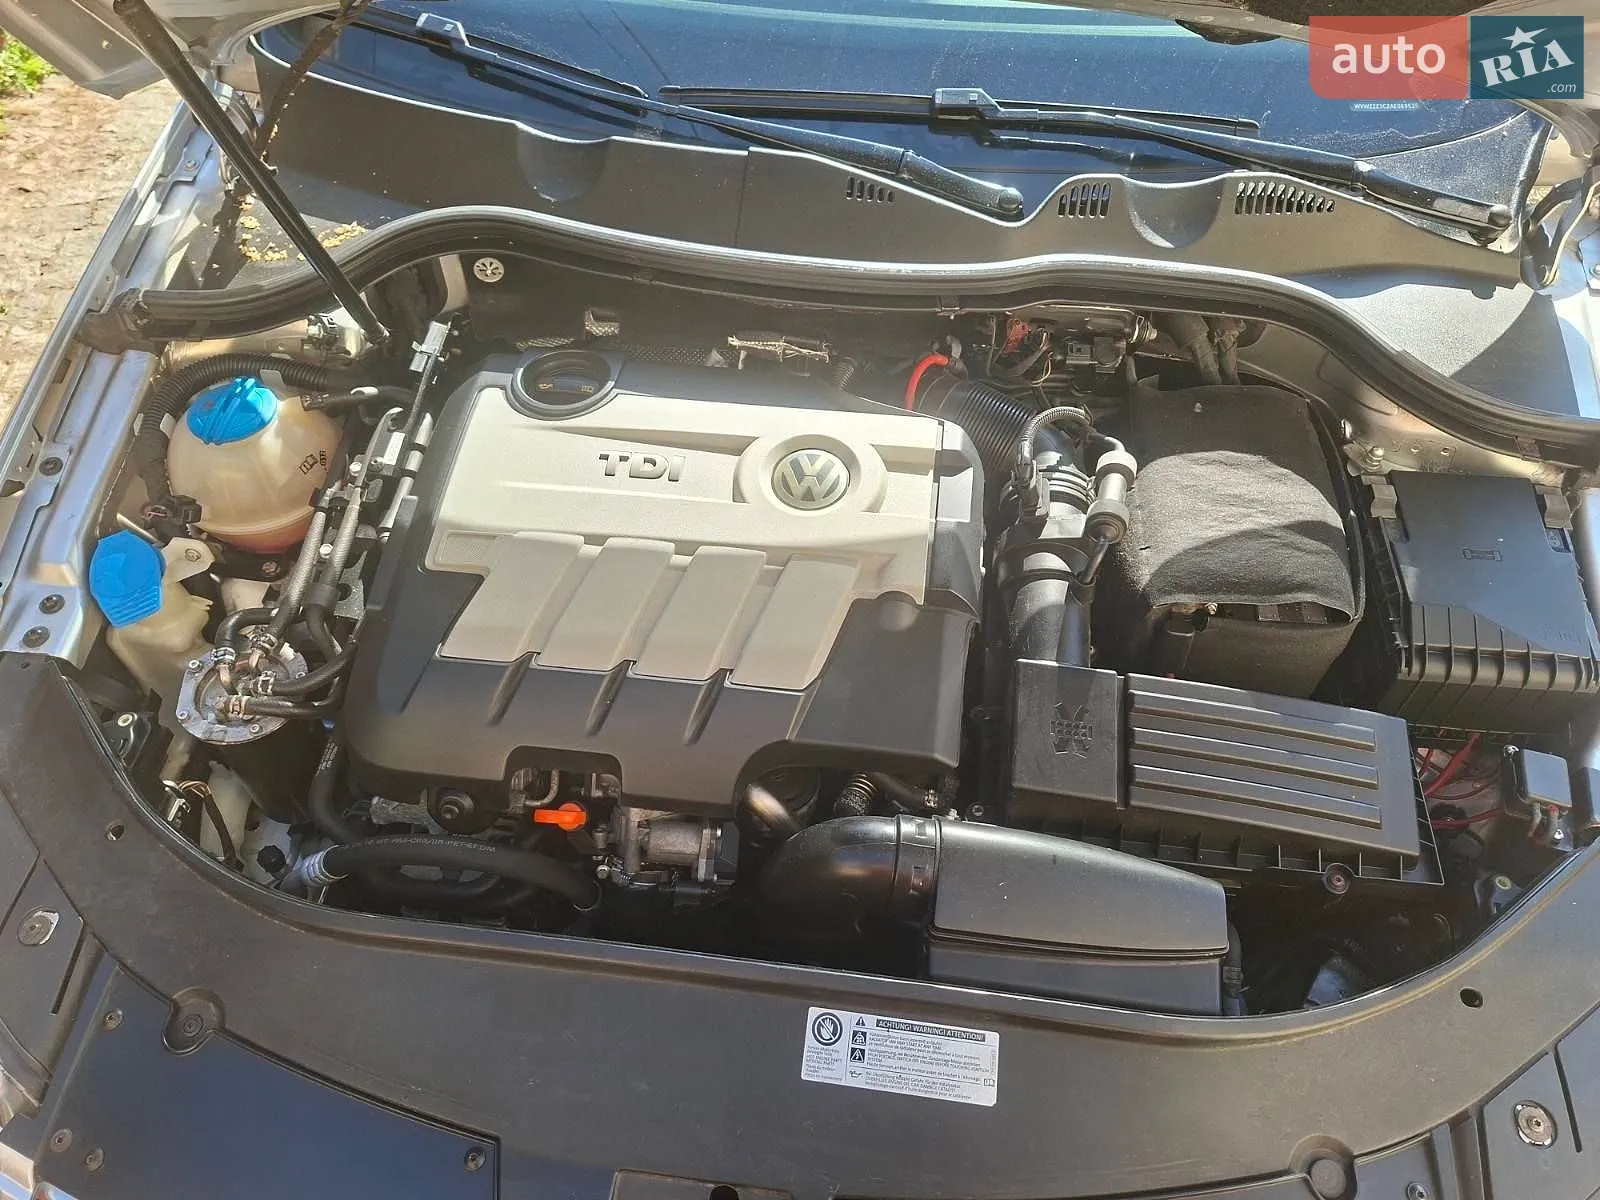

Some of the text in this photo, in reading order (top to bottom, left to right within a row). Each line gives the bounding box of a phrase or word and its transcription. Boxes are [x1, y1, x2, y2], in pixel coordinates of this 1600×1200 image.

[598, 450, 686, 482] TDI
[878, 1020, 912, 1031] ACHTUNG!
[913, 1025, 946, 1036] WARNING!
[947, 1029, 985, 1041] ATTENTION!
